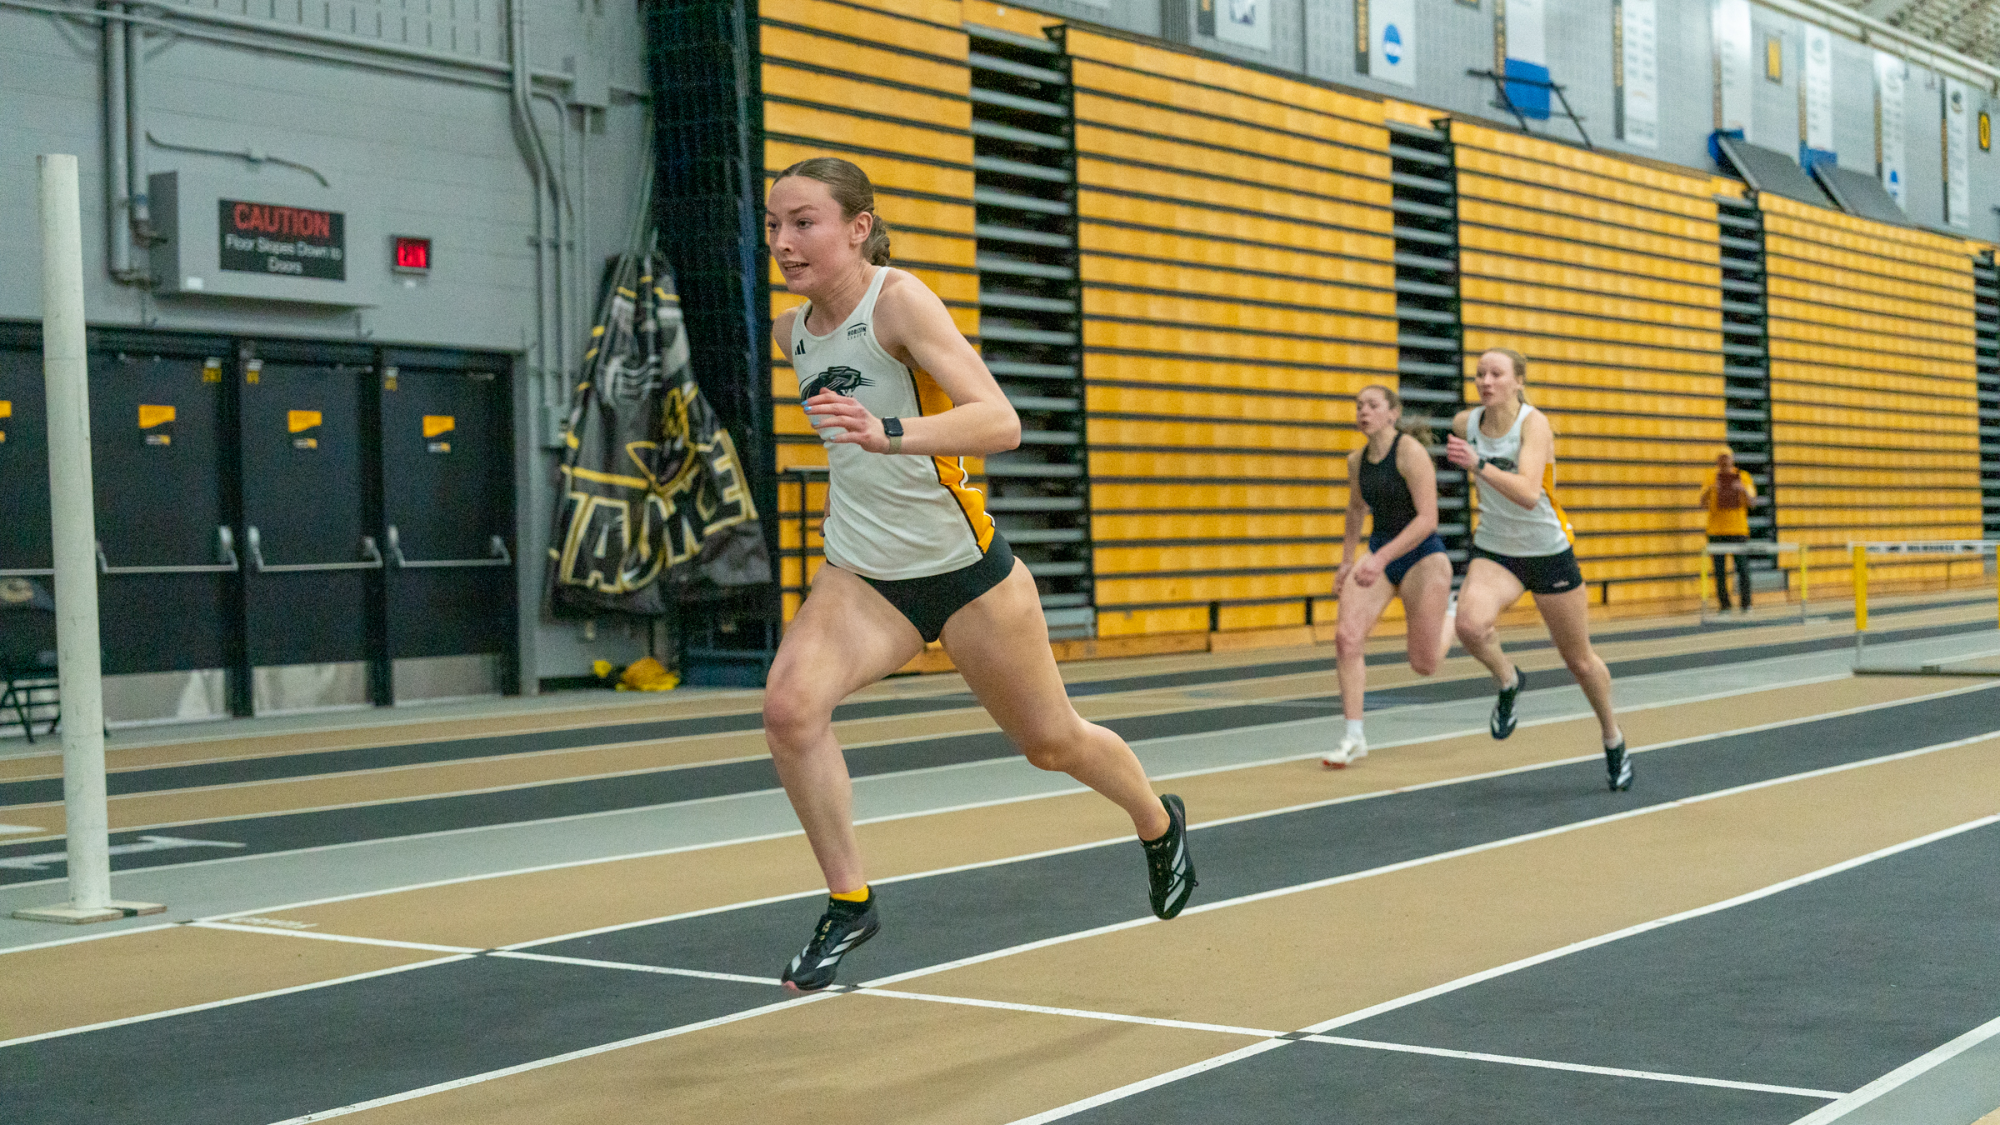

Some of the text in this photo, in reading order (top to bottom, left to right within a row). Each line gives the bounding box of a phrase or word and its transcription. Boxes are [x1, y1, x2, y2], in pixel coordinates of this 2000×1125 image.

[234, 202, 330, 238] CAUTION
[226, 234, 342, 260] Floor Slopes Down to
[268, 257, 303, 274] Doors
